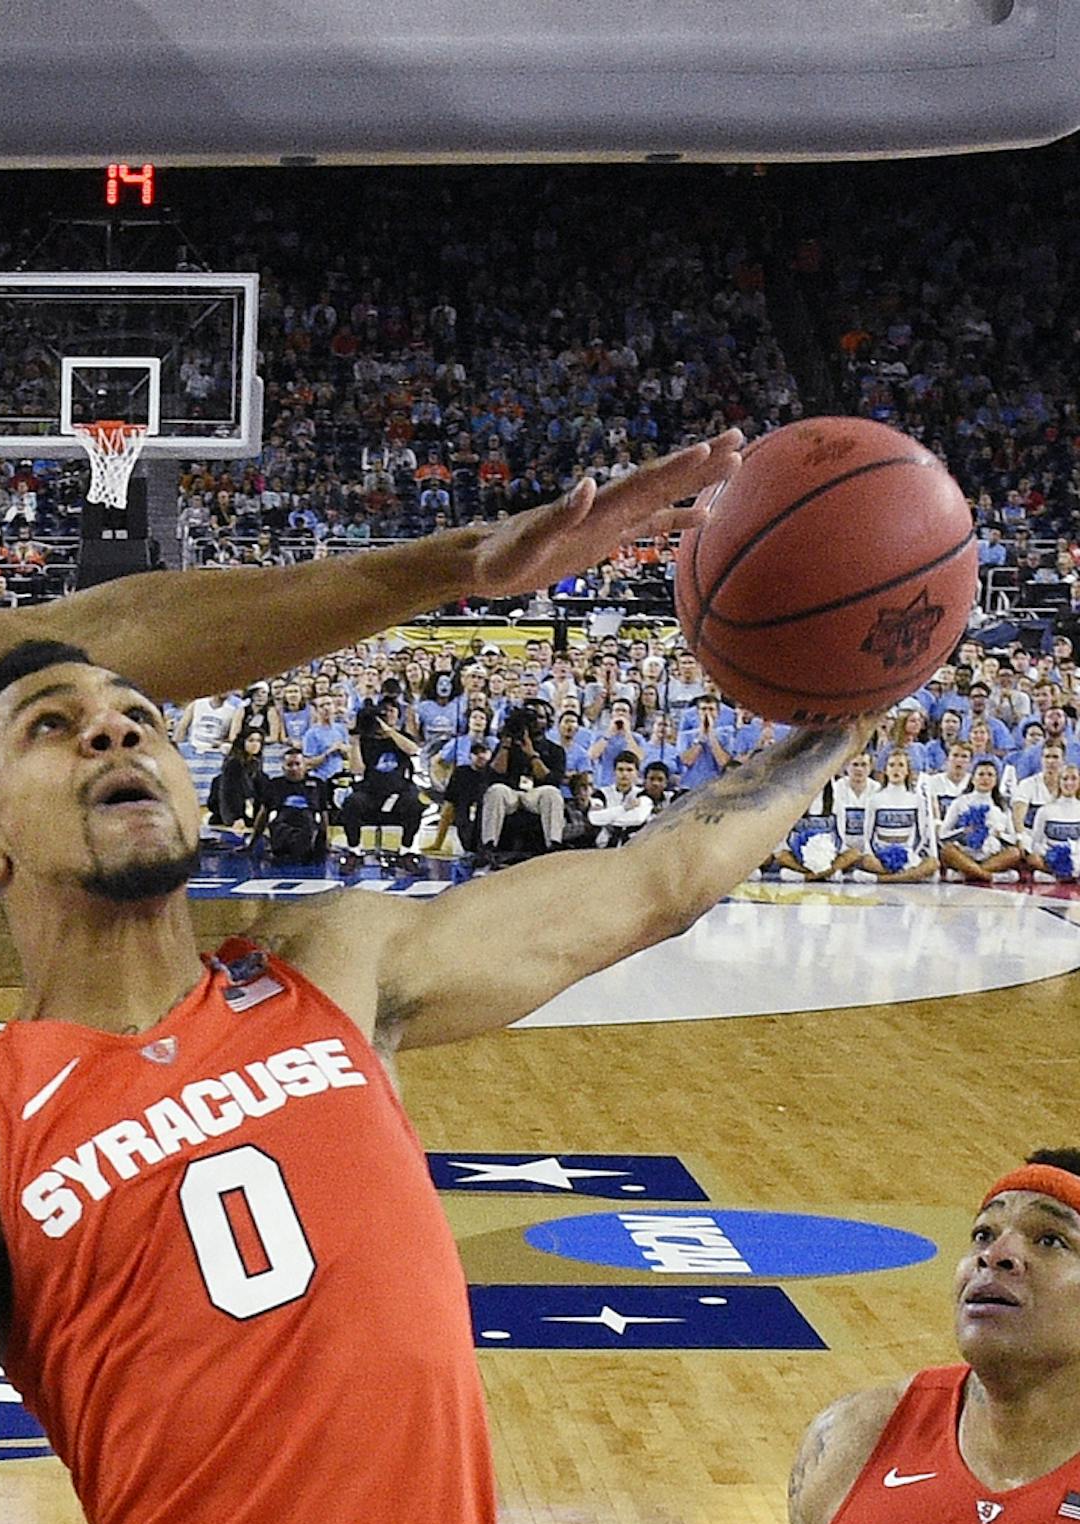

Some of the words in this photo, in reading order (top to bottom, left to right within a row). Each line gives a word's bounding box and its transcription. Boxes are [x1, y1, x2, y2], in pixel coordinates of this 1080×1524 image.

[106, 163, 155, 205] 14
[21, 1039, 368, 1238] SYRACUSE
[179, 1143, 318, 1322] 0
[617, 1213, 753, 1273] NCAA
